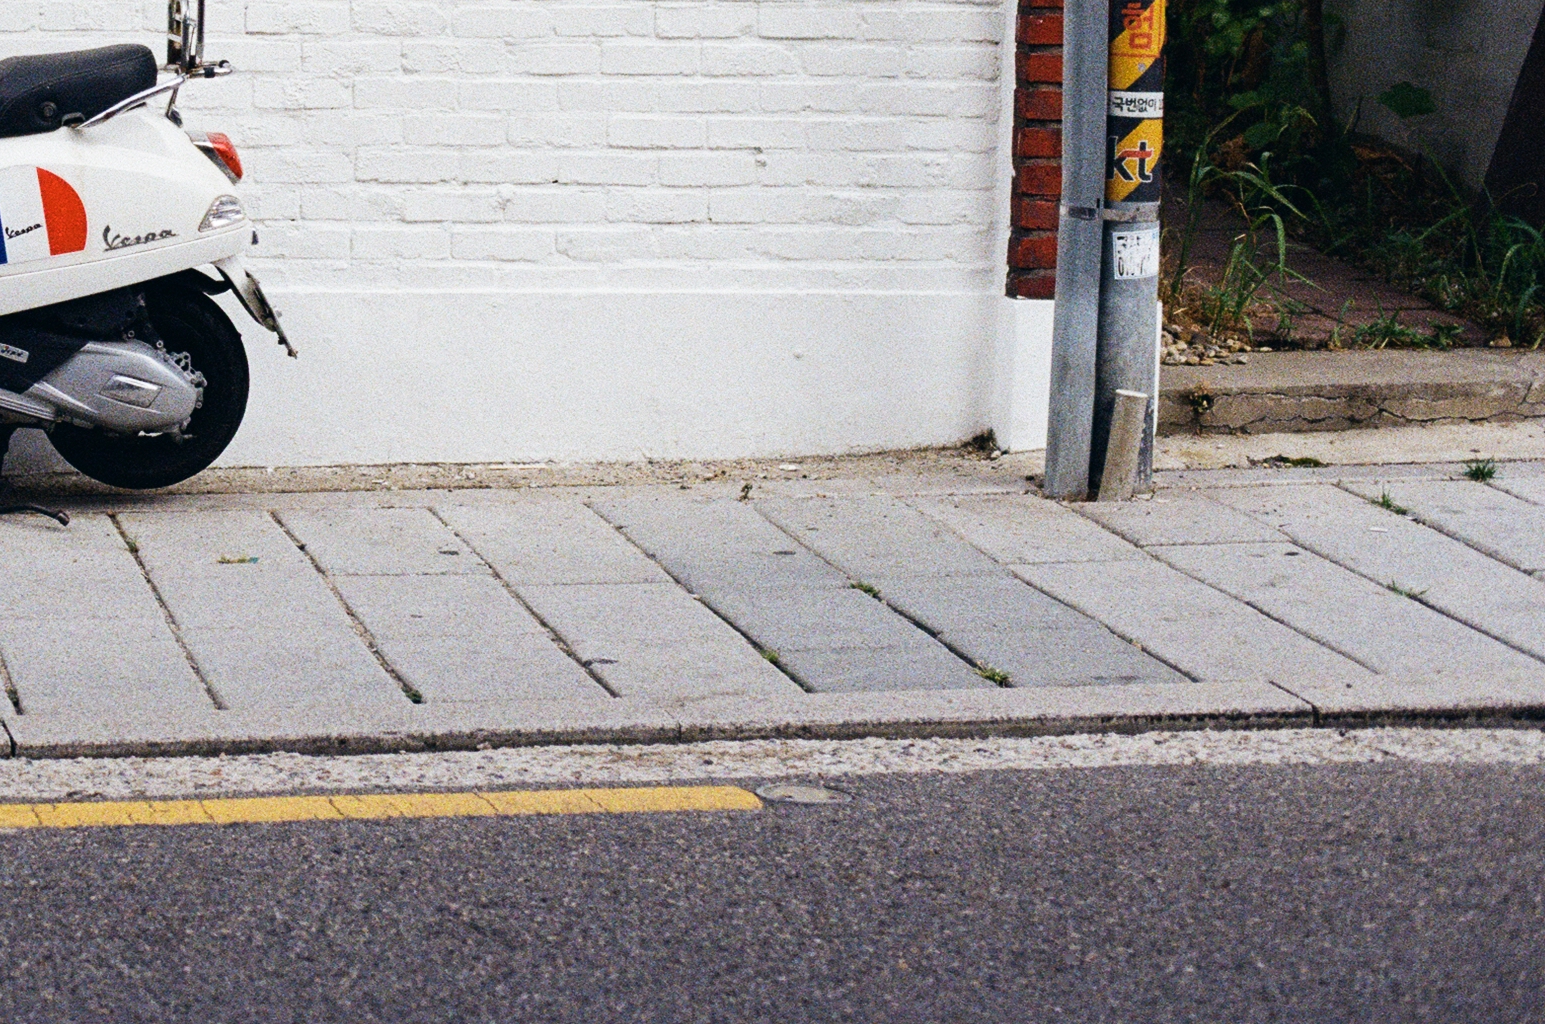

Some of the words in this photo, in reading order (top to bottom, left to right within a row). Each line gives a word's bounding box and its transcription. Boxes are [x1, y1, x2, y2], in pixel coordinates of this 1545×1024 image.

[1107, 135, 1153, 183] kt
[5, 222, 43, 240] Vespa
[102, 224, 177, 252] Vespa
